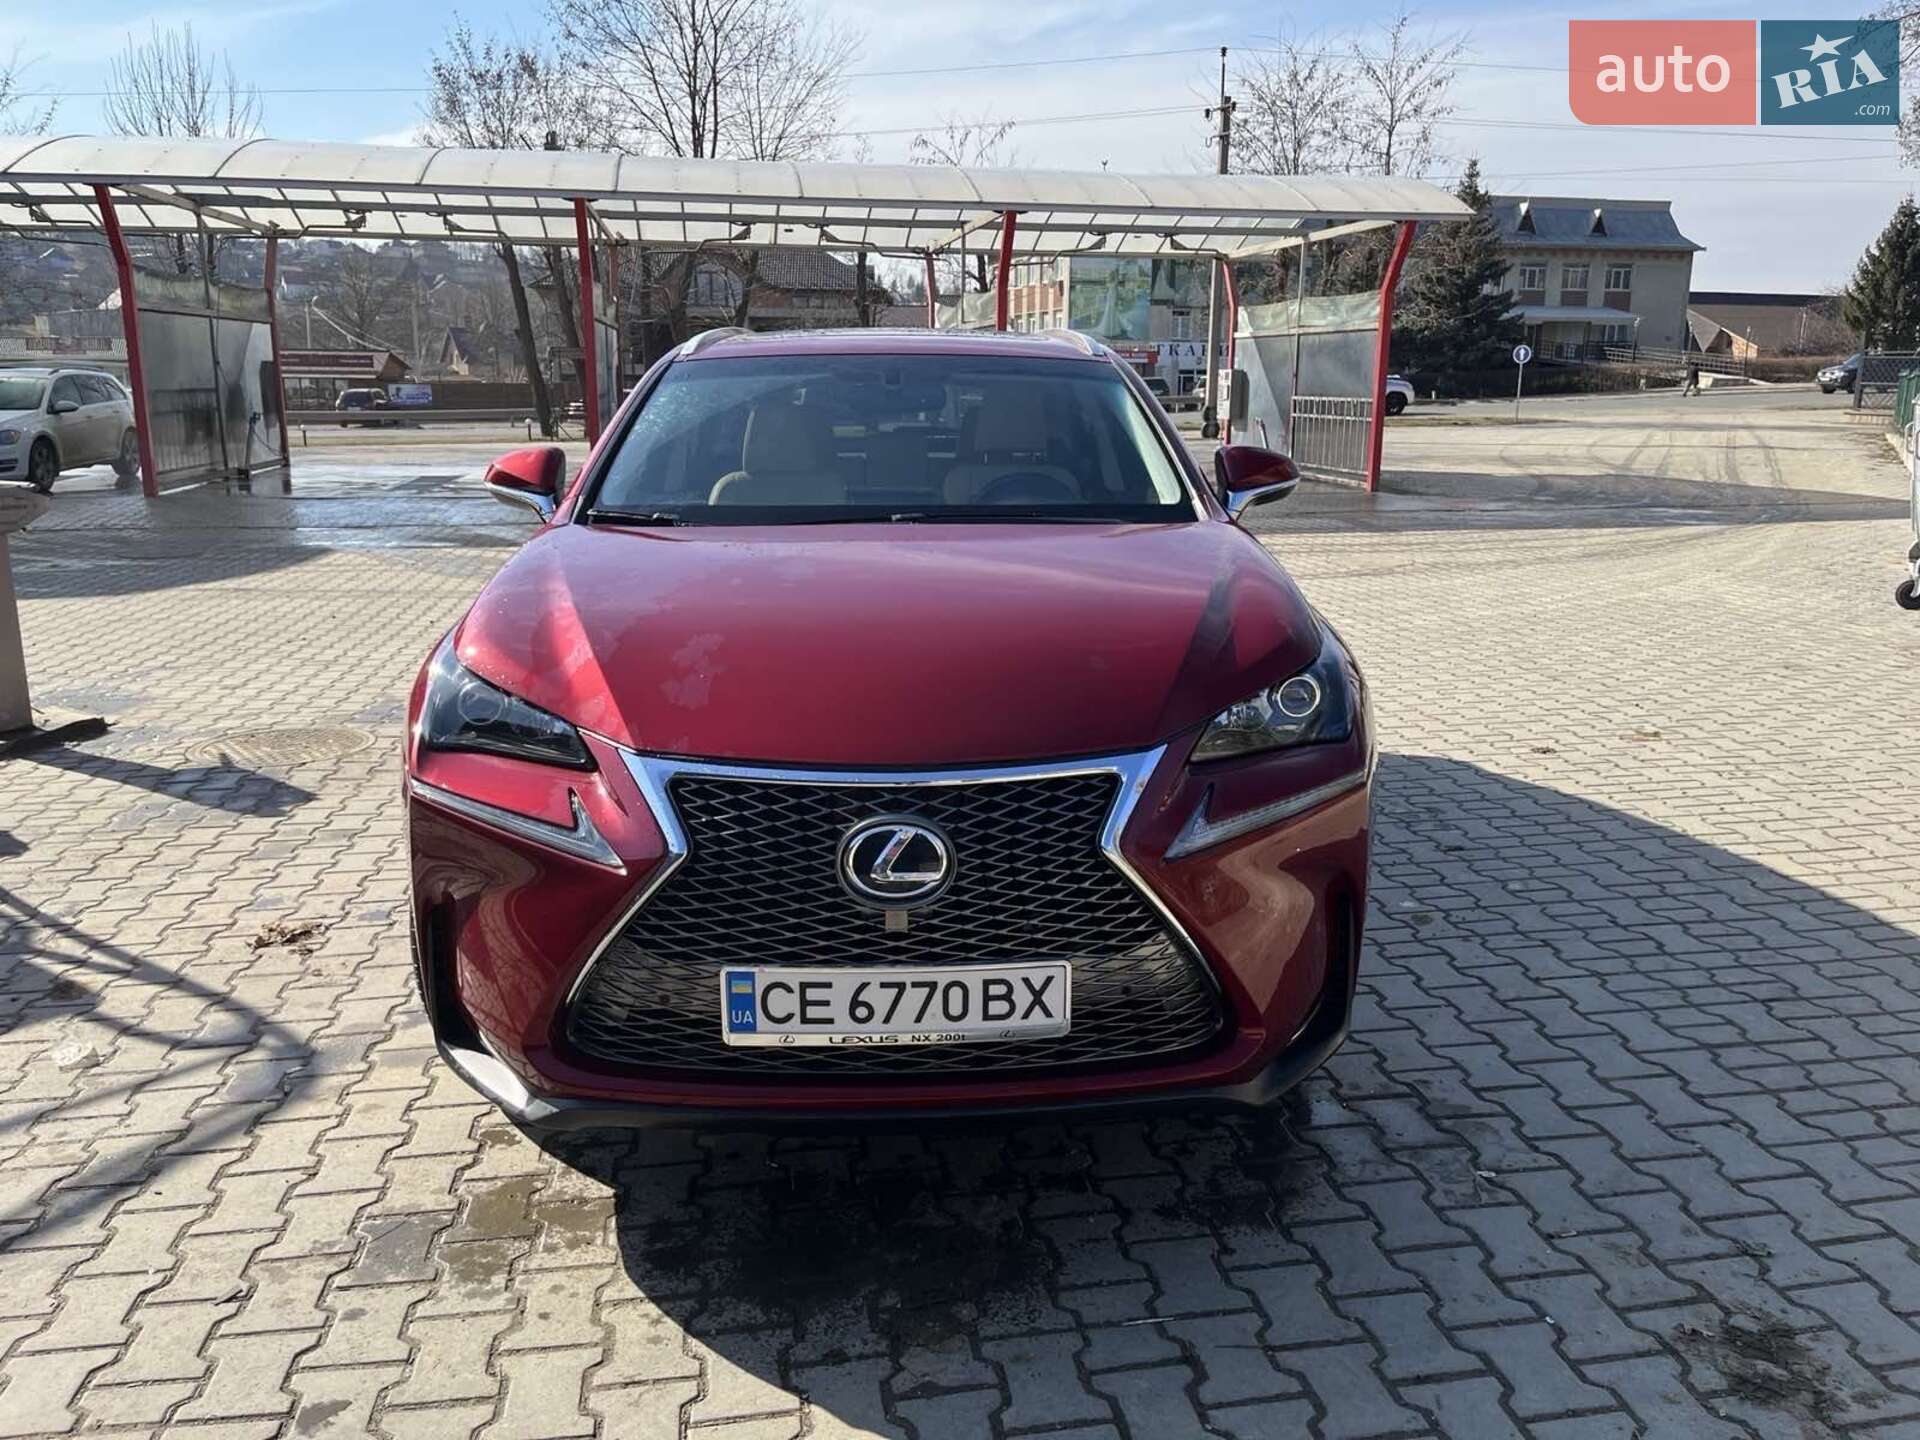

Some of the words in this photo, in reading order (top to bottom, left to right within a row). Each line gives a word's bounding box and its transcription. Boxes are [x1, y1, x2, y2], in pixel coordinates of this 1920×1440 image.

[760, 981, 834, 1025] CE
[848, 980, 970, 1025] 6770
[981, 975, 1055, 1022] BX
[731, 1010, 753, 1024] UA
[829, 1035, 899, 1045] LEXUS
[911, 1034, 933, 1043] NX
